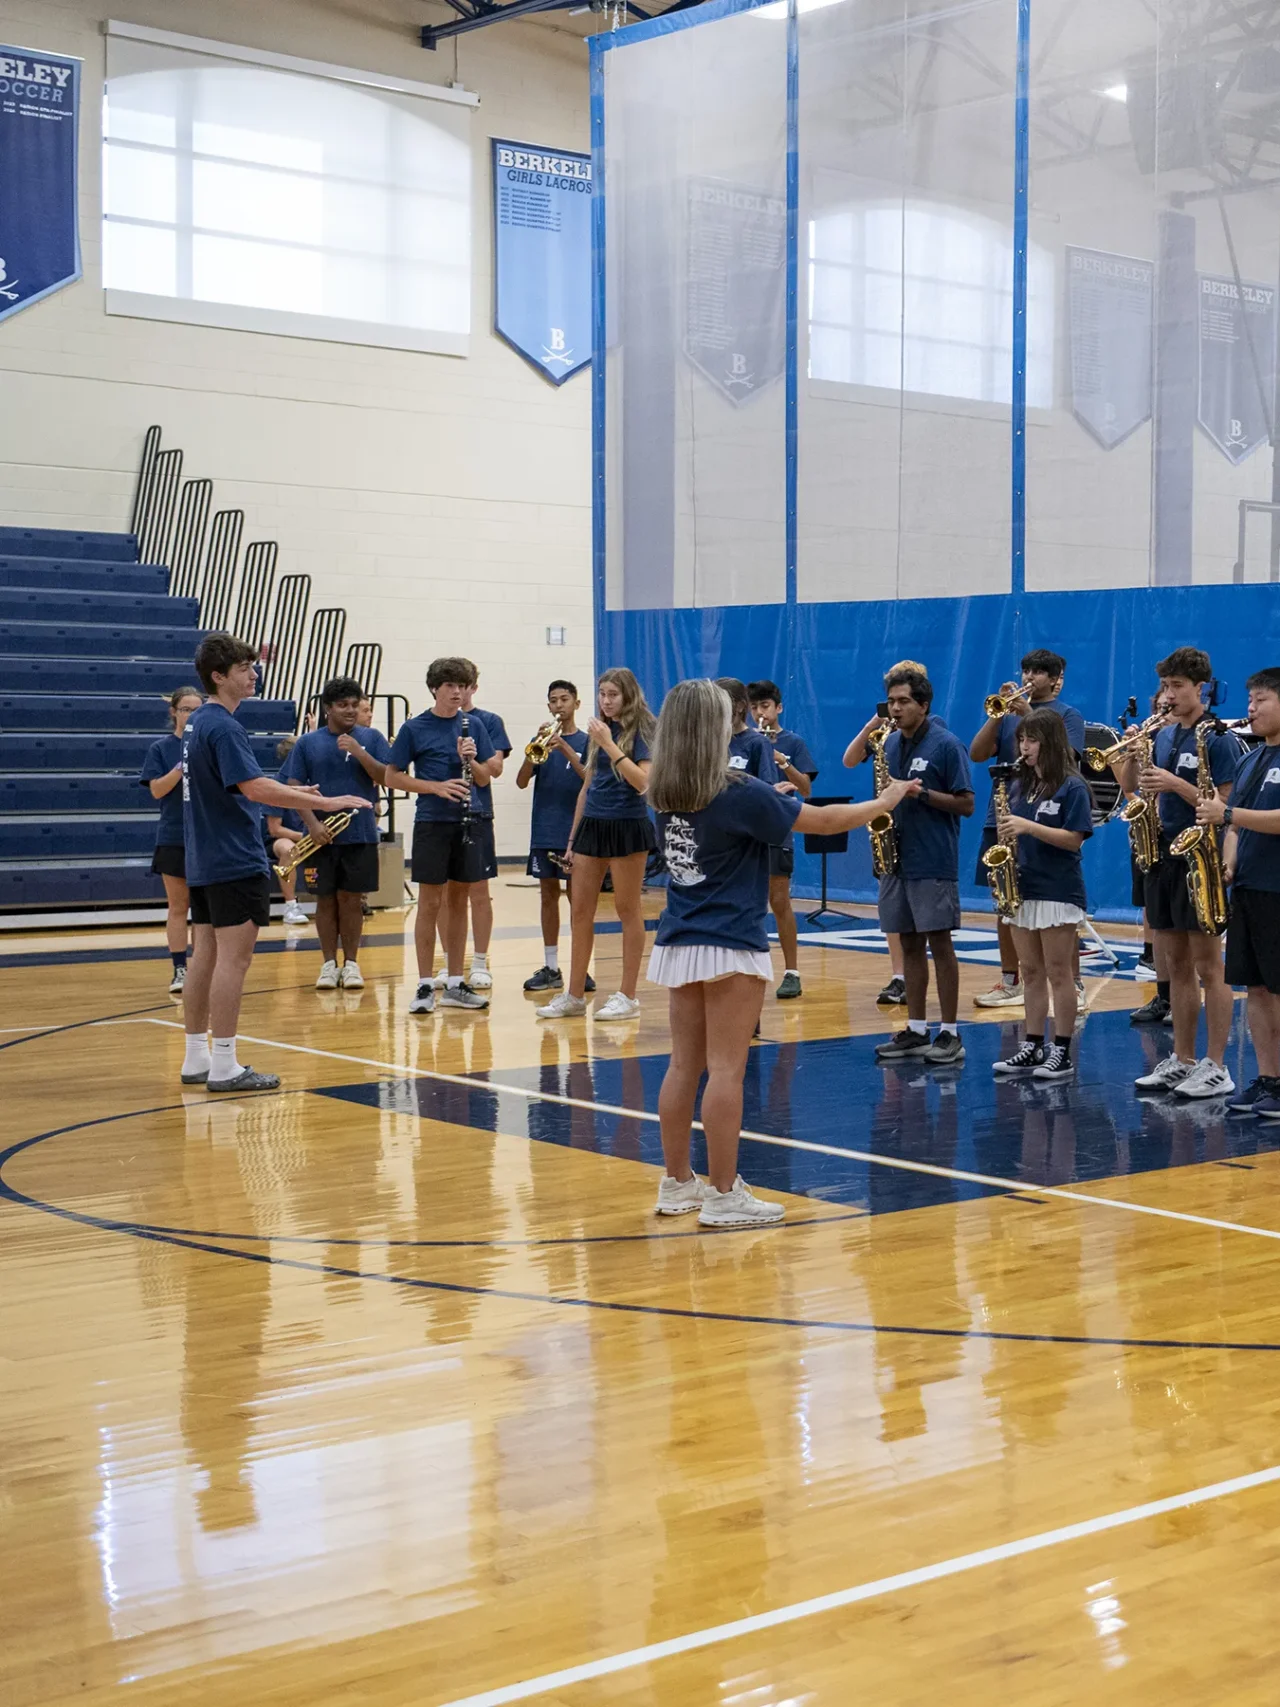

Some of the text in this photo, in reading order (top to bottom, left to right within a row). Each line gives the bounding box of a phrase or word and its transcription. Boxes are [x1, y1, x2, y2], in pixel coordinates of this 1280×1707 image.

[507, 170, 543, 186] GIRLS
[1074, 255, 1150, 282] BERKELEY
[550, 327, 565, 350] B
[731, 353, 746, 374] B
[1231, 419, 1242, 436] B
